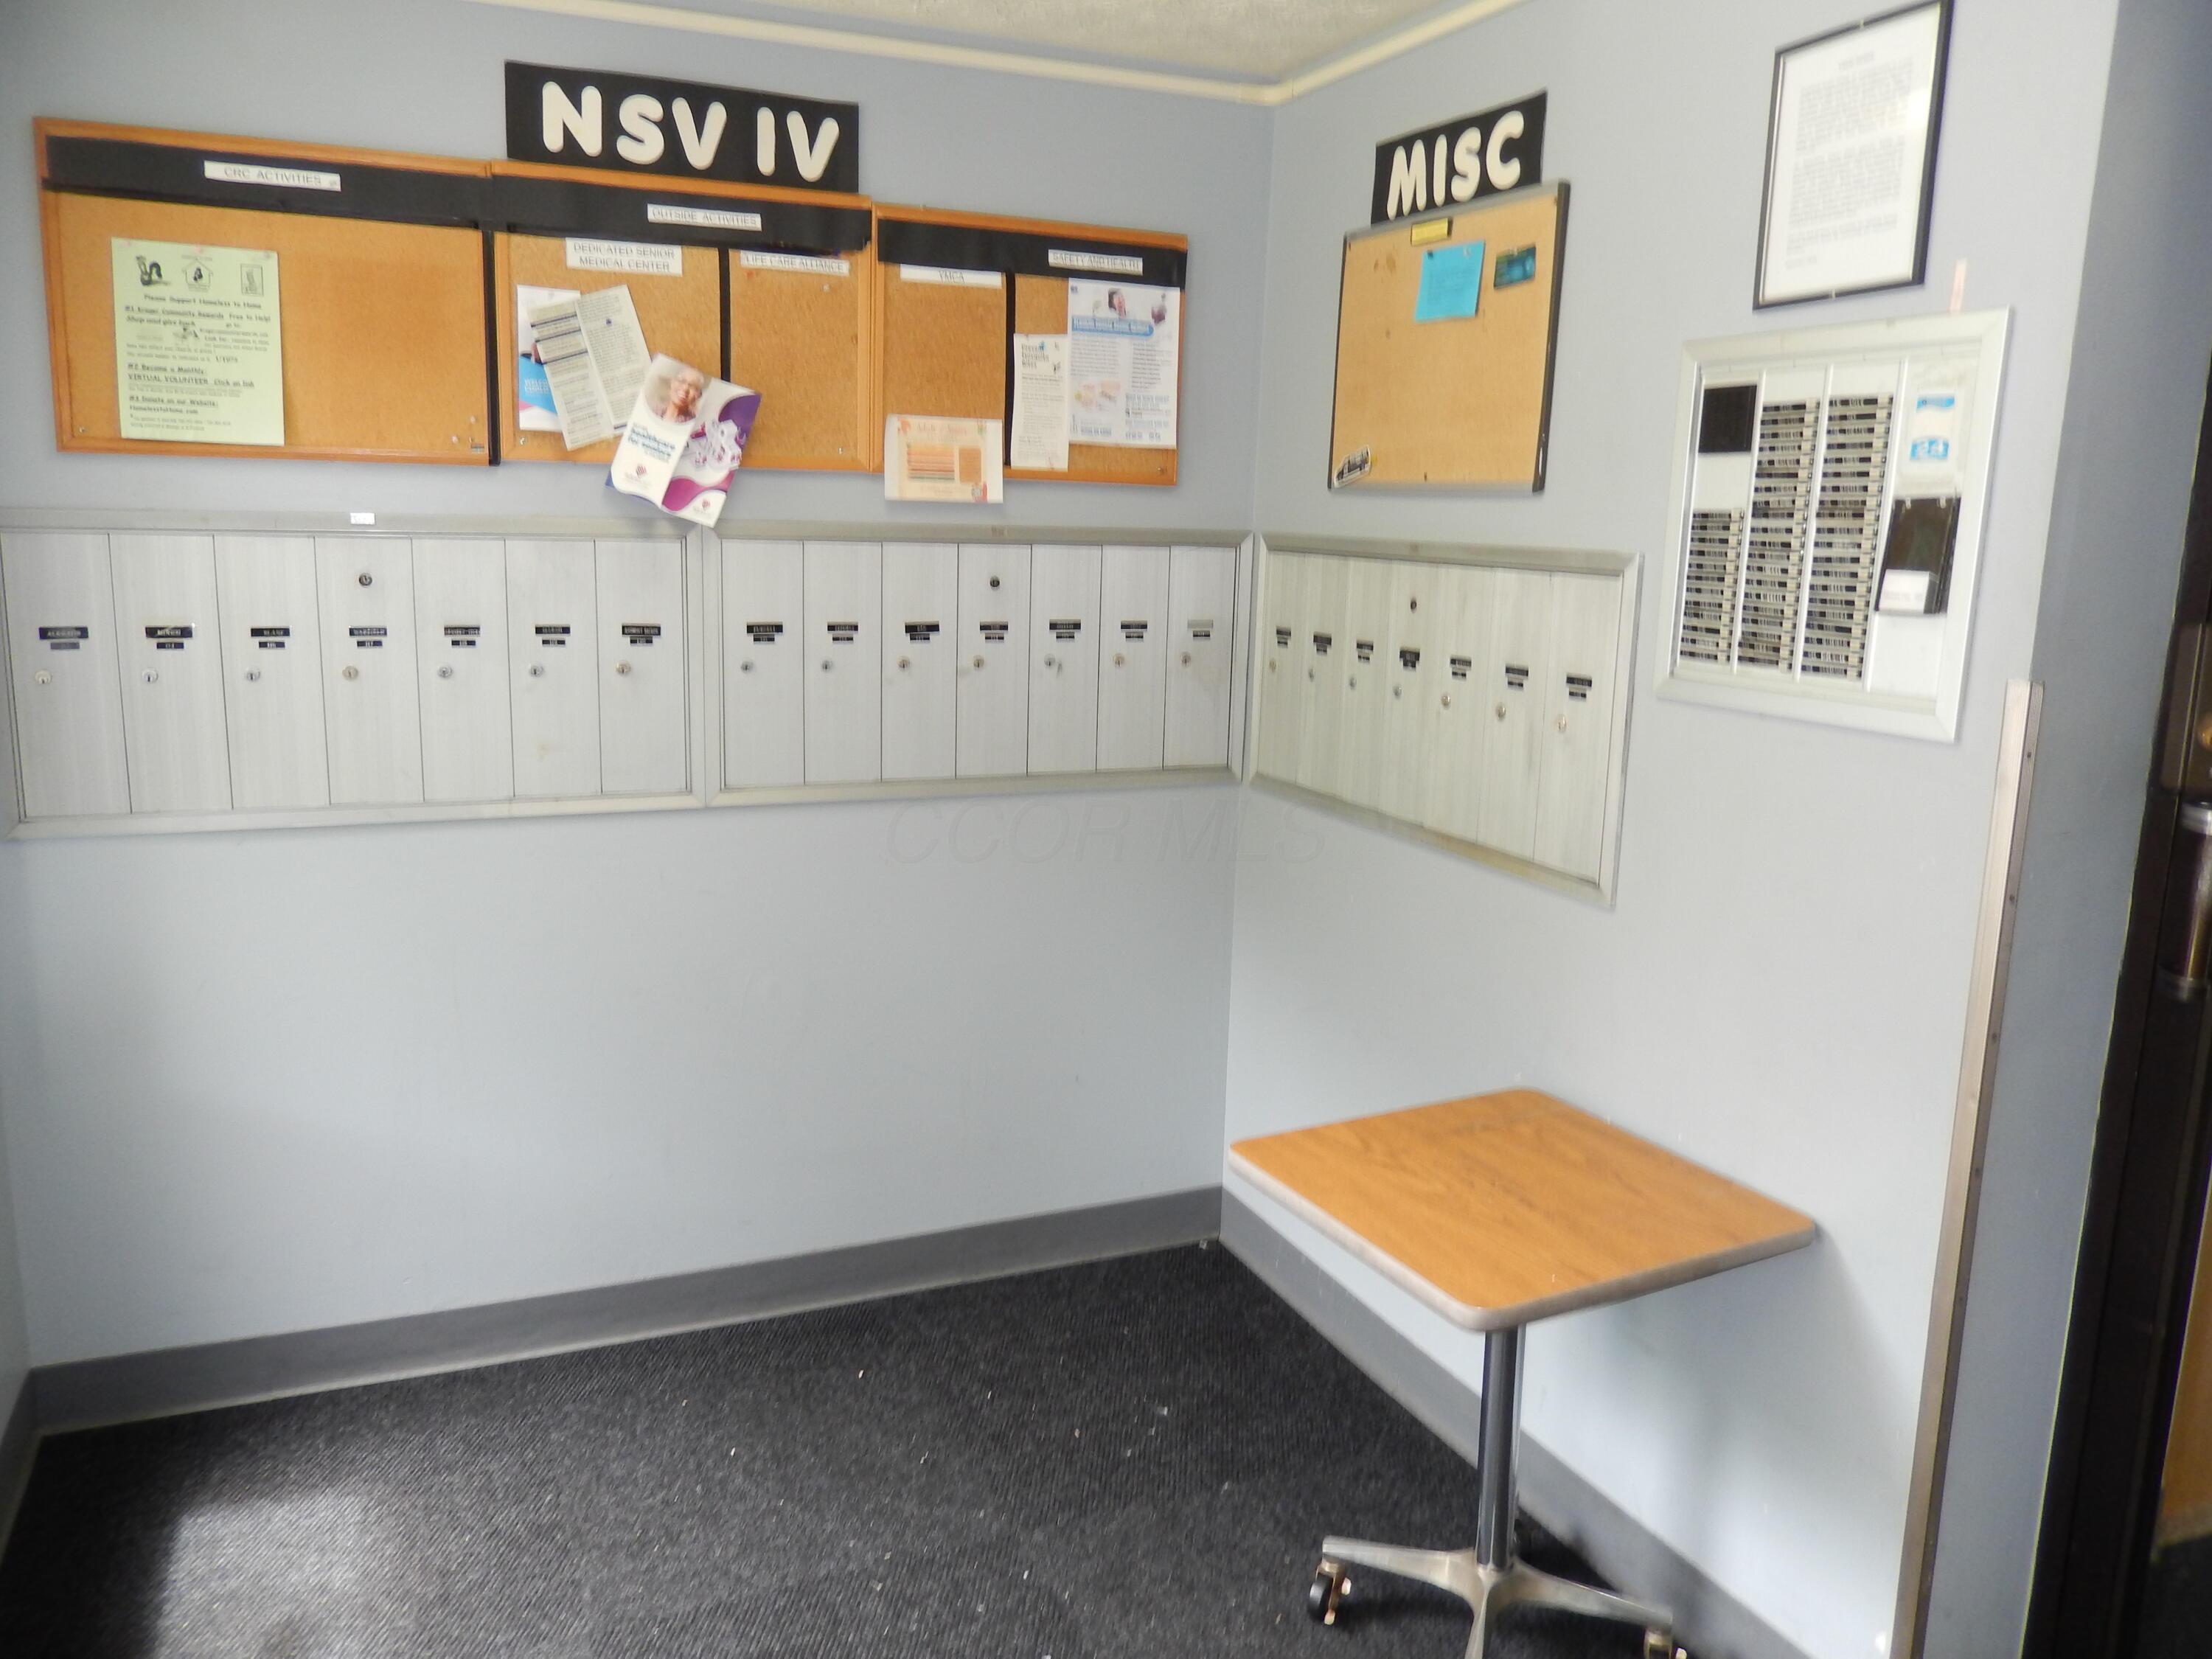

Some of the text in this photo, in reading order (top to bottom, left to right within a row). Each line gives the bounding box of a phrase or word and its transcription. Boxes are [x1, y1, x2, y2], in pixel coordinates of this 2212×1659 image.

[541, 81, 841, 183] NSV IV
[223, 165, 321, 184] CRC ACTIVITIES
[1385, 109, 1526, 221] MISC
[652, 207, 757, 226] OUTSIDE ACTIVITIES
[574, 241, 675, 260] DEDICATED SENIOR
[579, 256, 670, 273] MEDICAL CENTER
[746, 252, 844, 274] LIFE CARE ALLIANCE
[938, 269, 966, 284] YMCA
